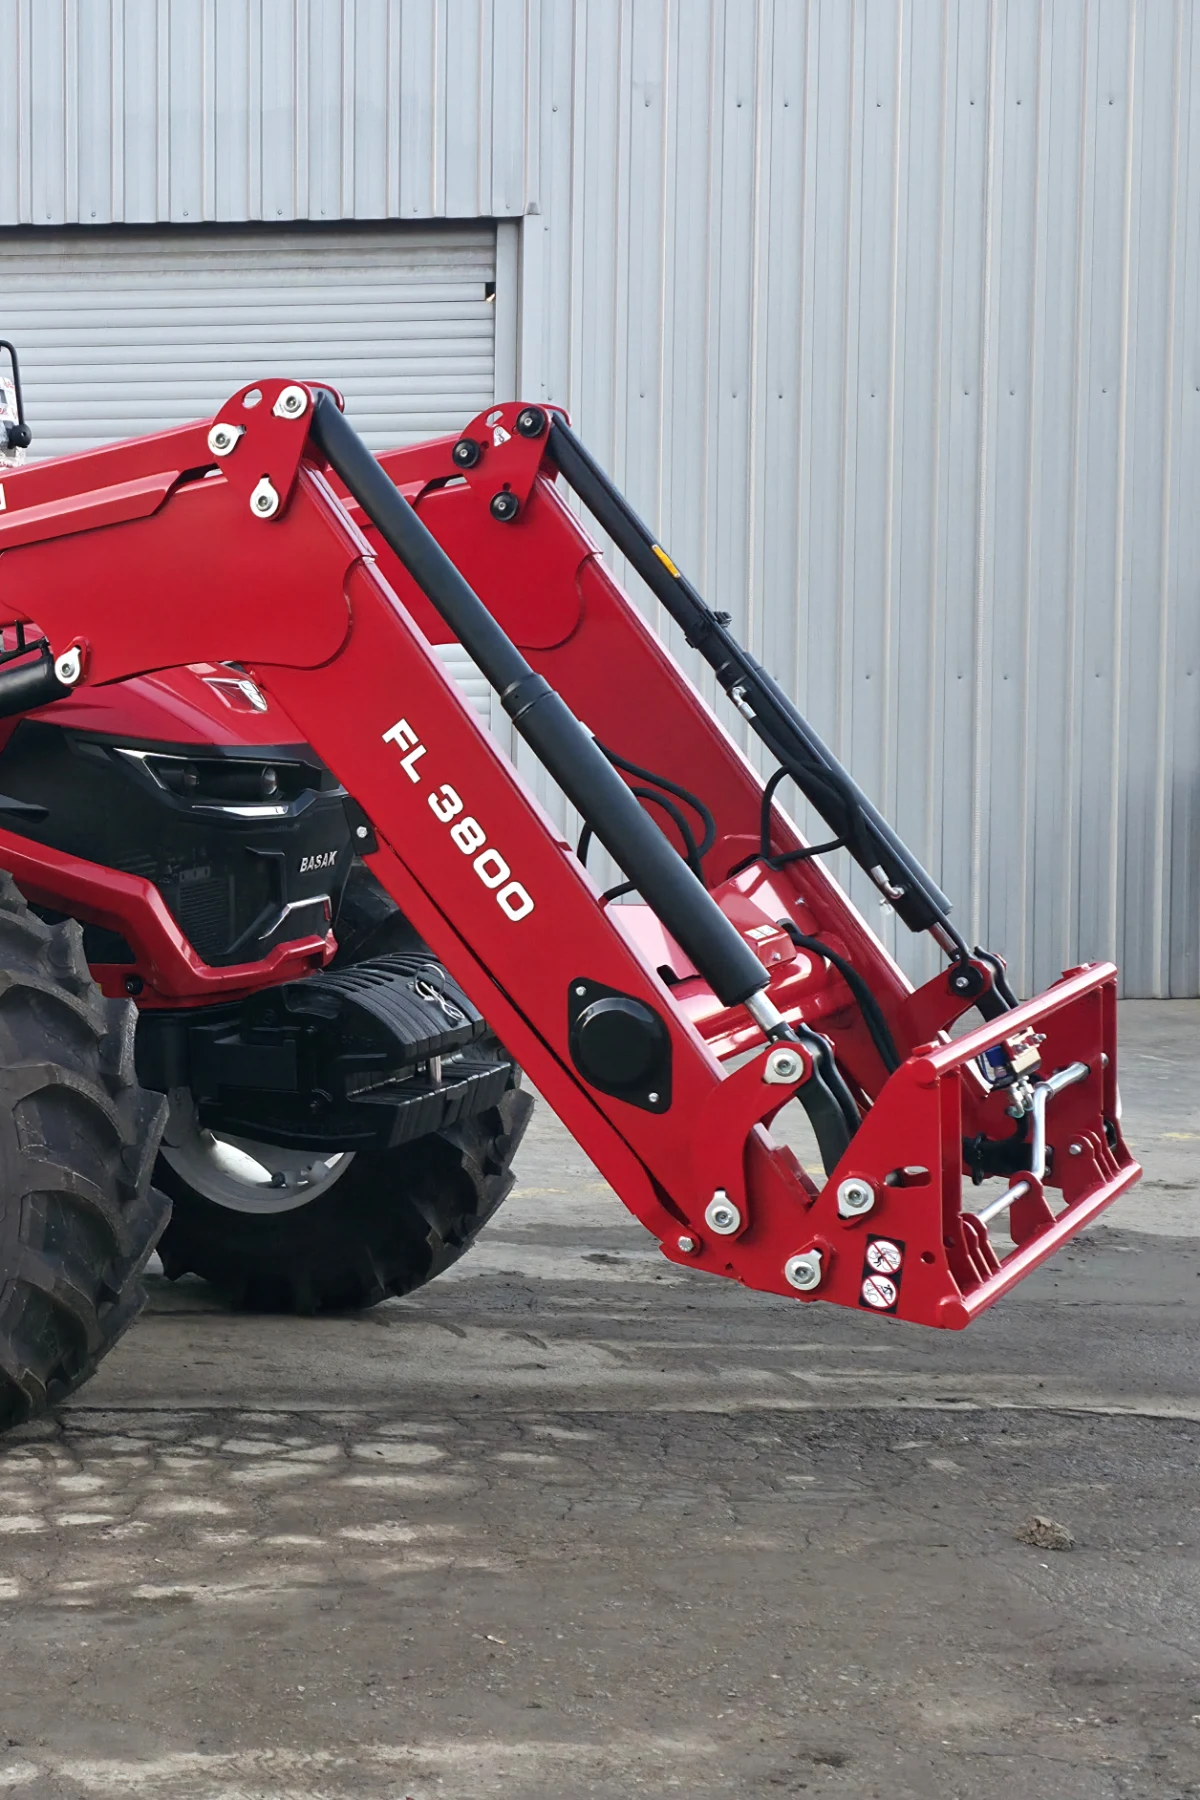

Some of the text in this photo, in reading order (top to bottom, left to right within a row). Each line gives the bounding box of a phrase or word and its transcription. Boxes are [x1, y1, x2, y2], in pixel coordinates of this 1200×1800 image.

[300, 850, 338, 873] BASAK
[381, 718, 535, 922] FL 3800
